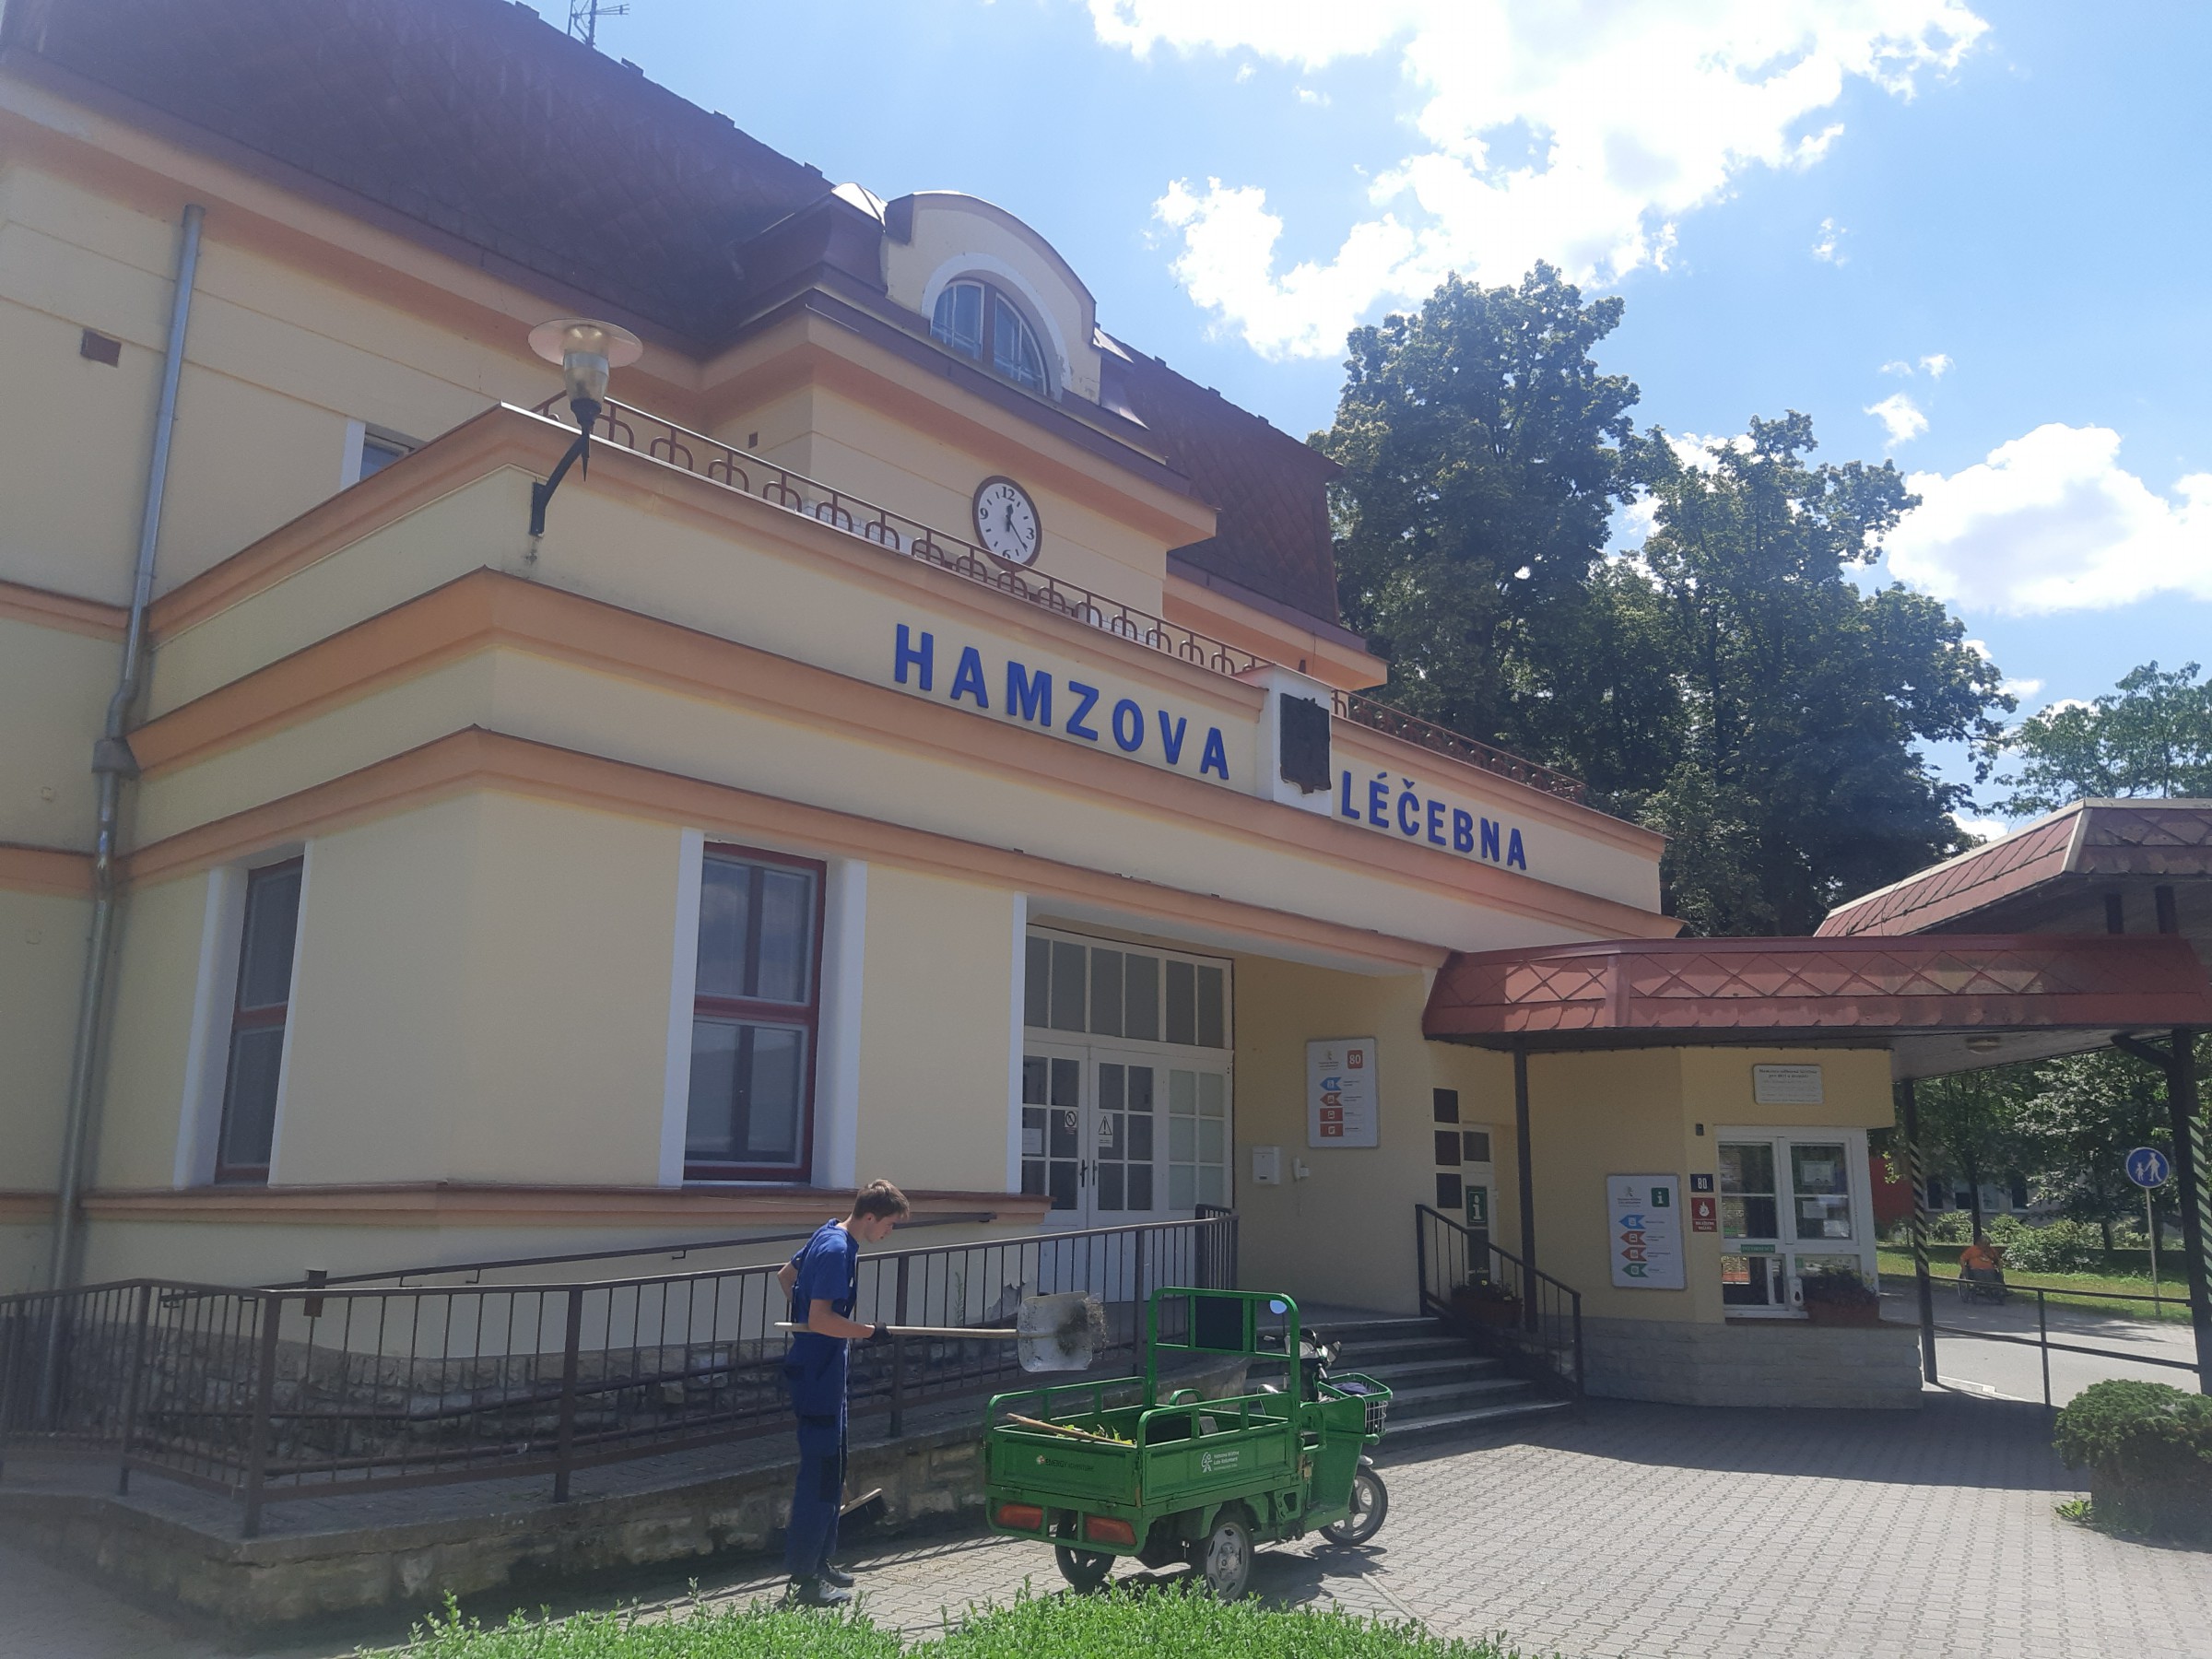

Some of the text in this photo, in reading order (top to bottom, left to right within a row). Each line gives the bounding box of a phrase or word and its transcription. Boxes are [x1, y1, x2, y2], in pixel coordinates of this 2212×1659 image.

[1002, 486, 1016, 502] 12
[979, 507, 989, 520] 9
[1026, 527, 1035, 540] 3
[895, 623, 1528, 871] HAMZOVA LÉČEBNA
[1349, 1054, 1361, 1065] 80
[1697, 1177, 1708, 1190] 80
